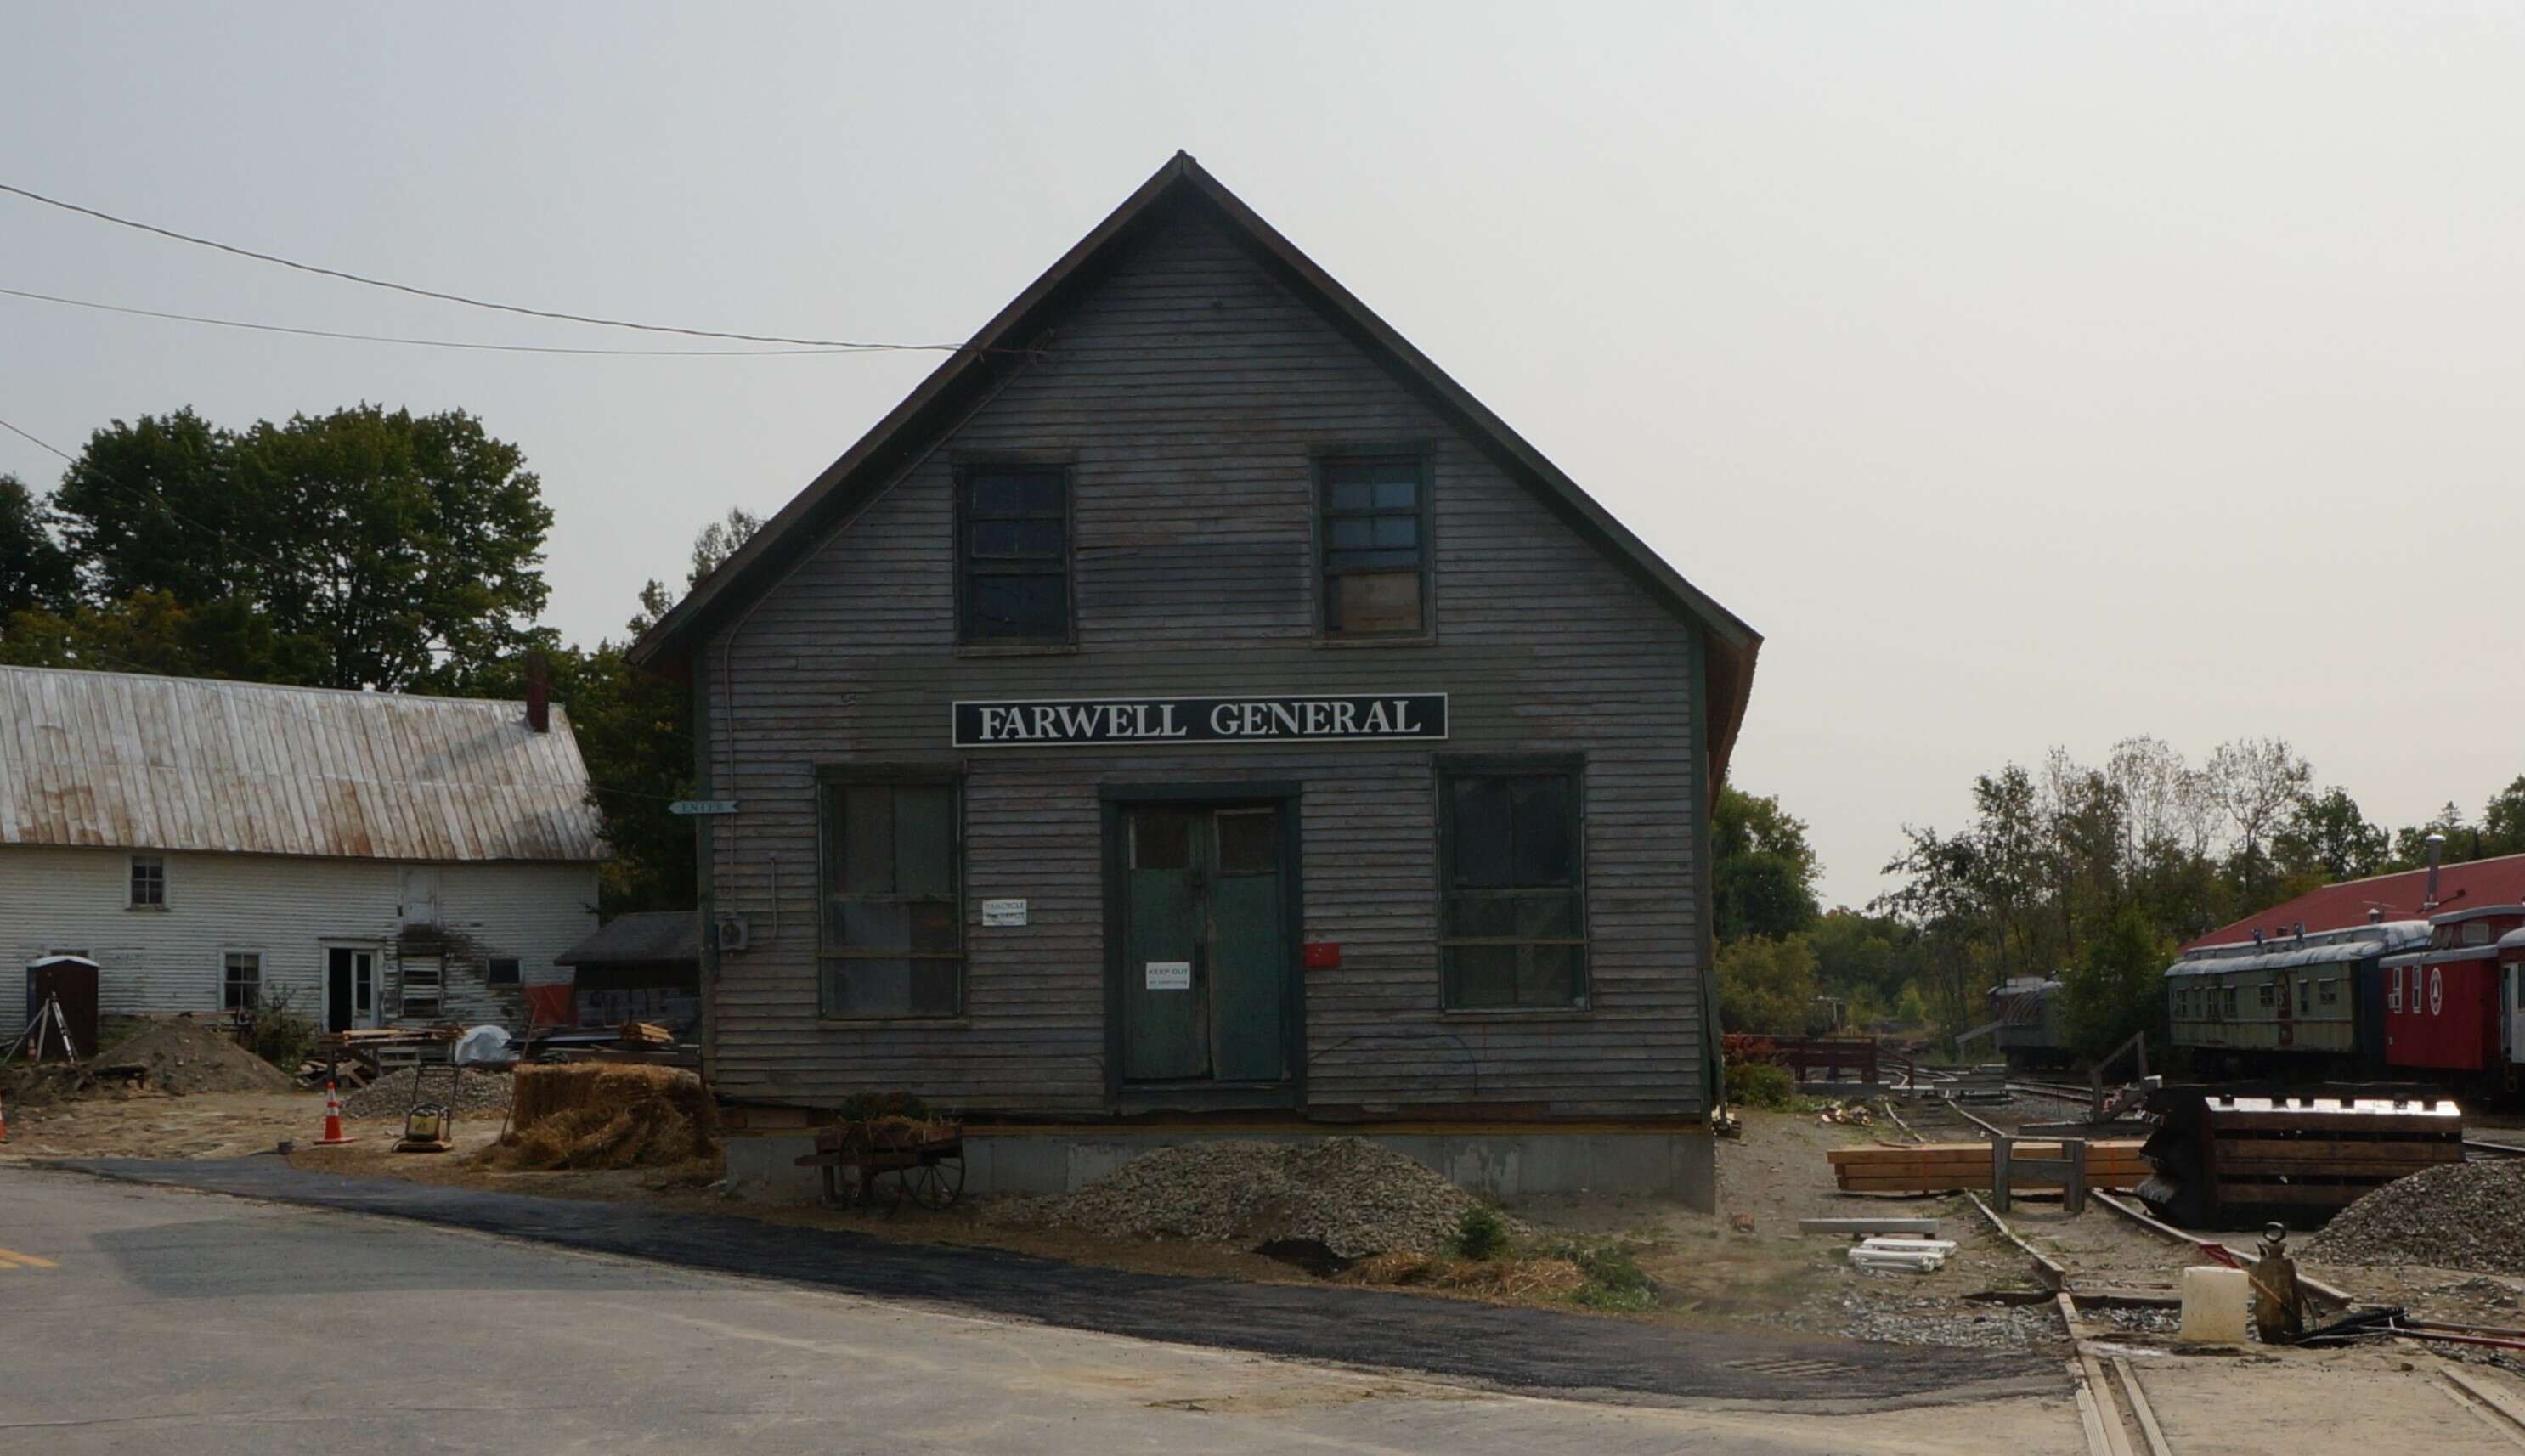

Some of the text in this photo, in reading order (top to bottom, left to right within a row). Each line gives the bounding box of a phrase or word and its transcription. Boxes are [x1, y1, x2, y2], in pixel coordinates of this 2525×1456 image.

[979, 700, 1421, 740] FARWELL GENERAL
[682, 802, 725, 812] ENTER
